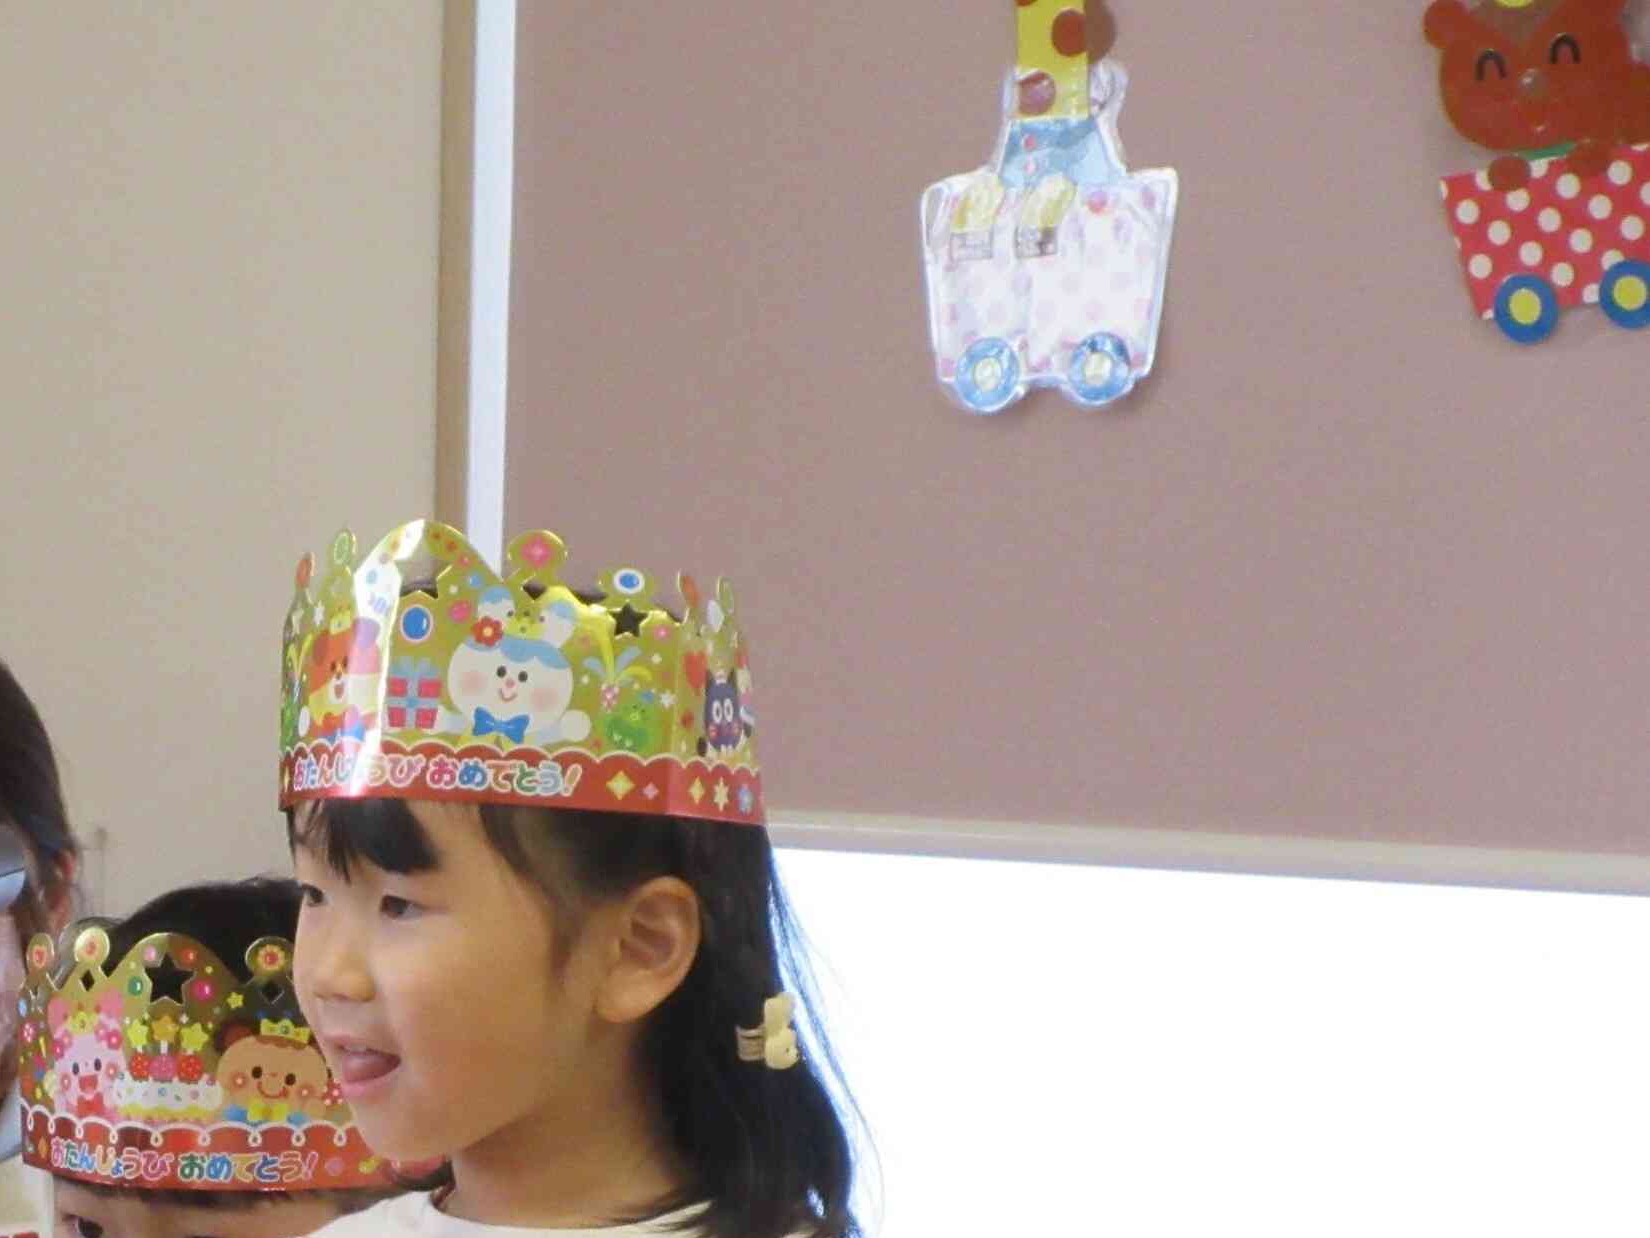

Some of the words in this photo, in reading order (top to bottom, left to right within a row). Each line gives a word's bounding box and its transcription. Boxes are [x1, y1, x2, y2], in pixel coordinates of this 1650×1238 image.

[293, 752, 426, 790] おたんじうび
[426, 753, 583, 797] おめでとう!
[49, 1136, 175, 1181] おたんじょうび
[177, 1150, 319, 1184] おめでとう!
